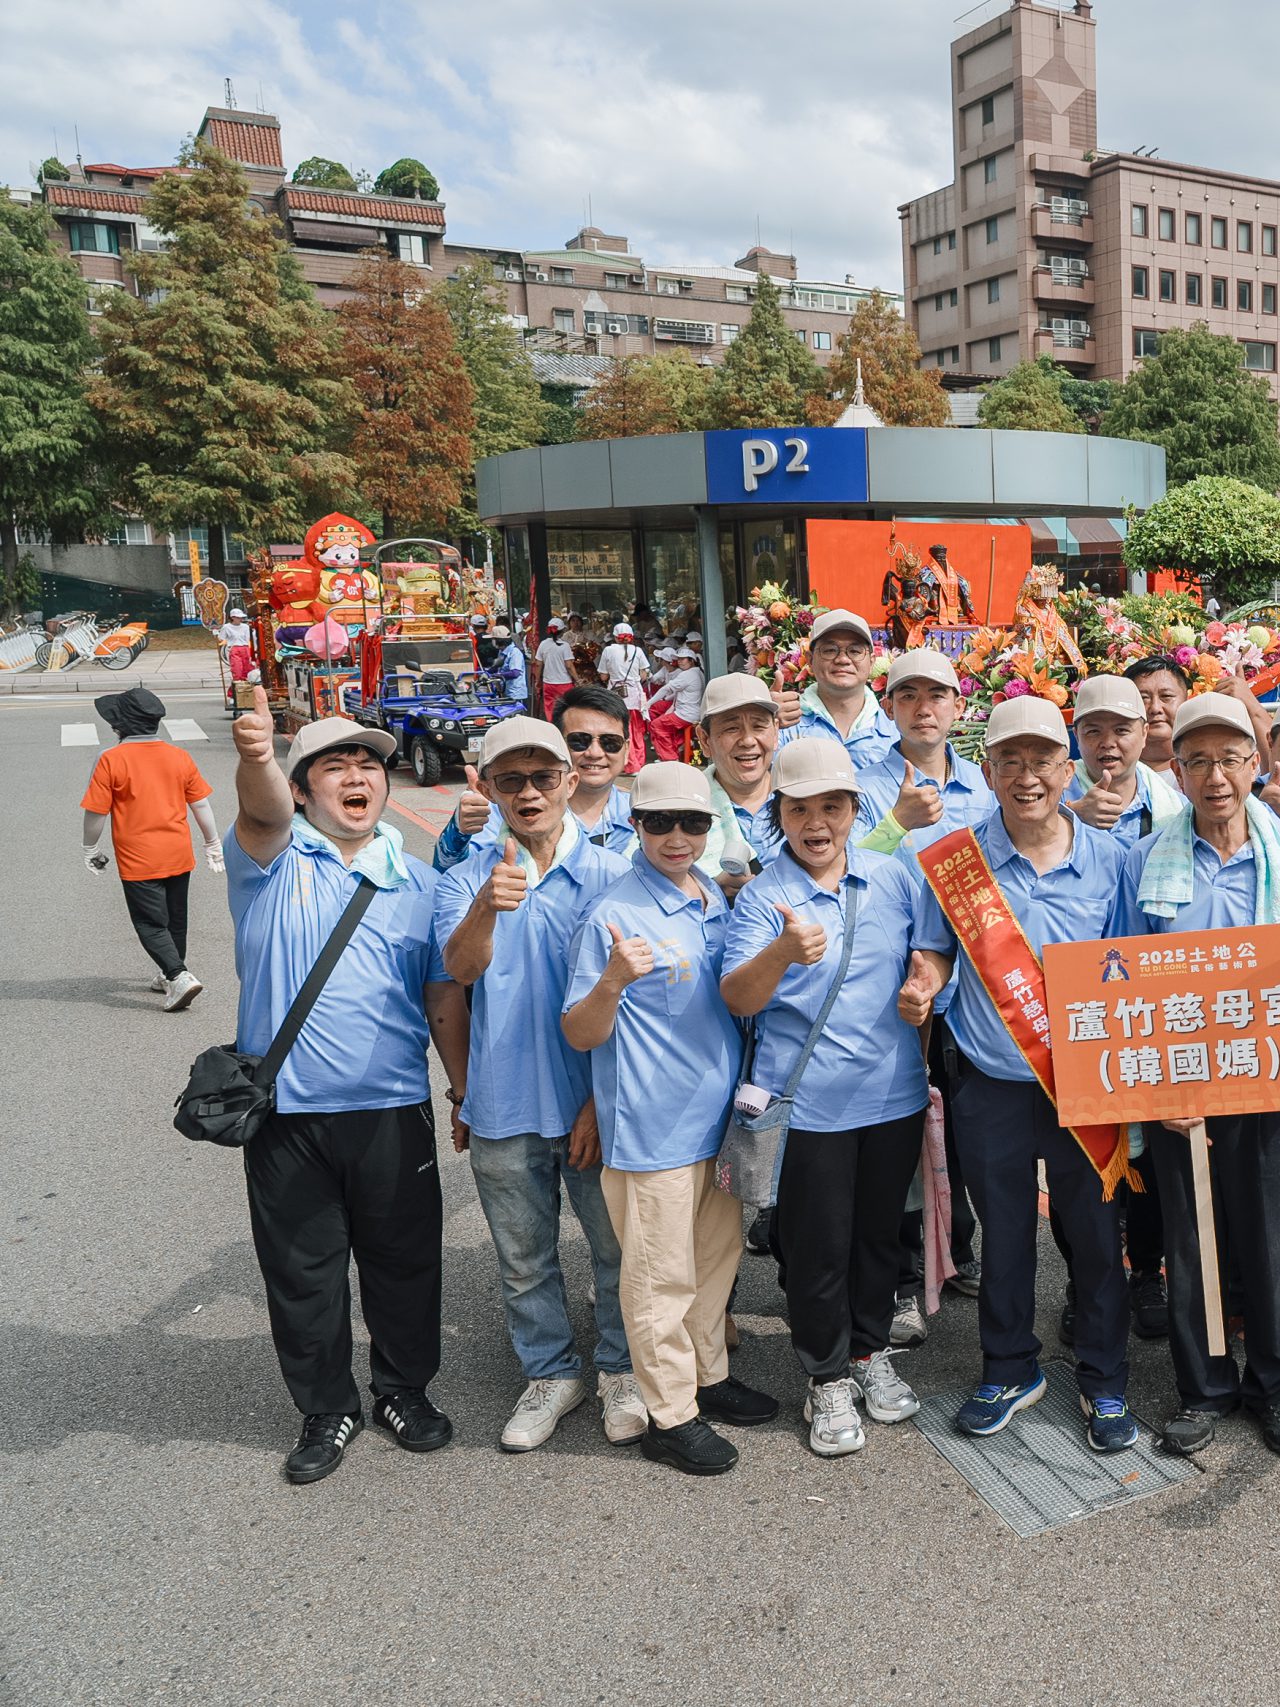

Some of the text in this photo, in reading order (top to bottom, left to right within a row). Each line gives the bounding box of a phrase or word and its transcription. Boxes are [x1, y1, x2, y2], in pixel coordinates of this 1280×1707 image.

[932, 846, 973, 878] 2025
[939, 875, 949, 884] TU
[962, 868, 1005, 929] 土地公
[1138, 942, 1256, 966] 2025 土地公
[1164, 962, 1188, 971] GONG
[1099, 1036, 1280, 1093] (韓國媽)
